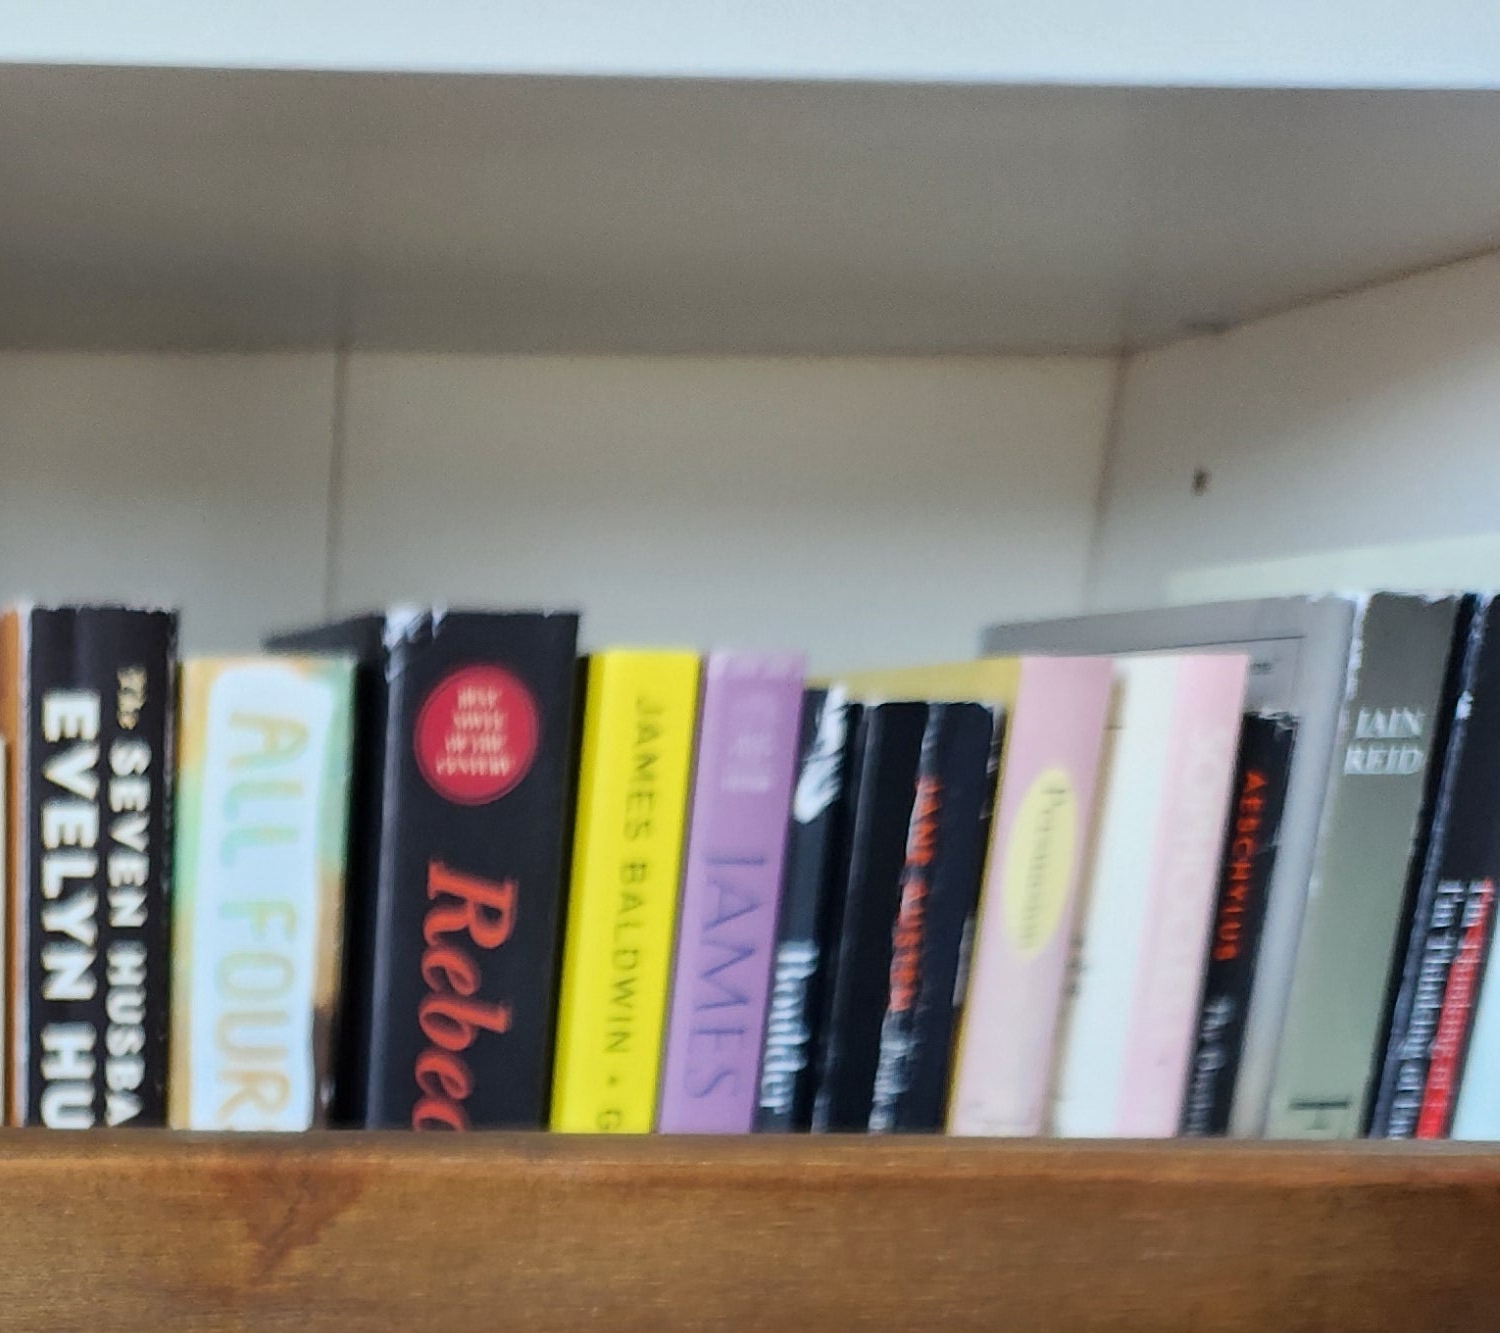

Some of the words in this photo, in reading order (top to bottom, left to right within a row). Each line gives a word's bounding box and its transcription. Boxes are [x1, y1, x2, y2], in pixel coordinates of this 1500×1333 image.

[219, 708, 311, 868] ALL
[623, 697, 664, 842] JAMES
[1343, 743, 1426, 776] REID
[1354, 707, 1427, 739] IAIN
[39, 690, 104, 1000] EVELYN
[105, 740, 154, 928] SEVEN
[102, 938, 149, 1128] HUSBA
[212, 900, 298, 1129] FOUR
[410, 857, 518, 1130] Rebec
[602, 861, 647, 1056] BALDWIN
[682, 853, 768, 1101] JAMES
[39, 1020, 99, 1129] HU
